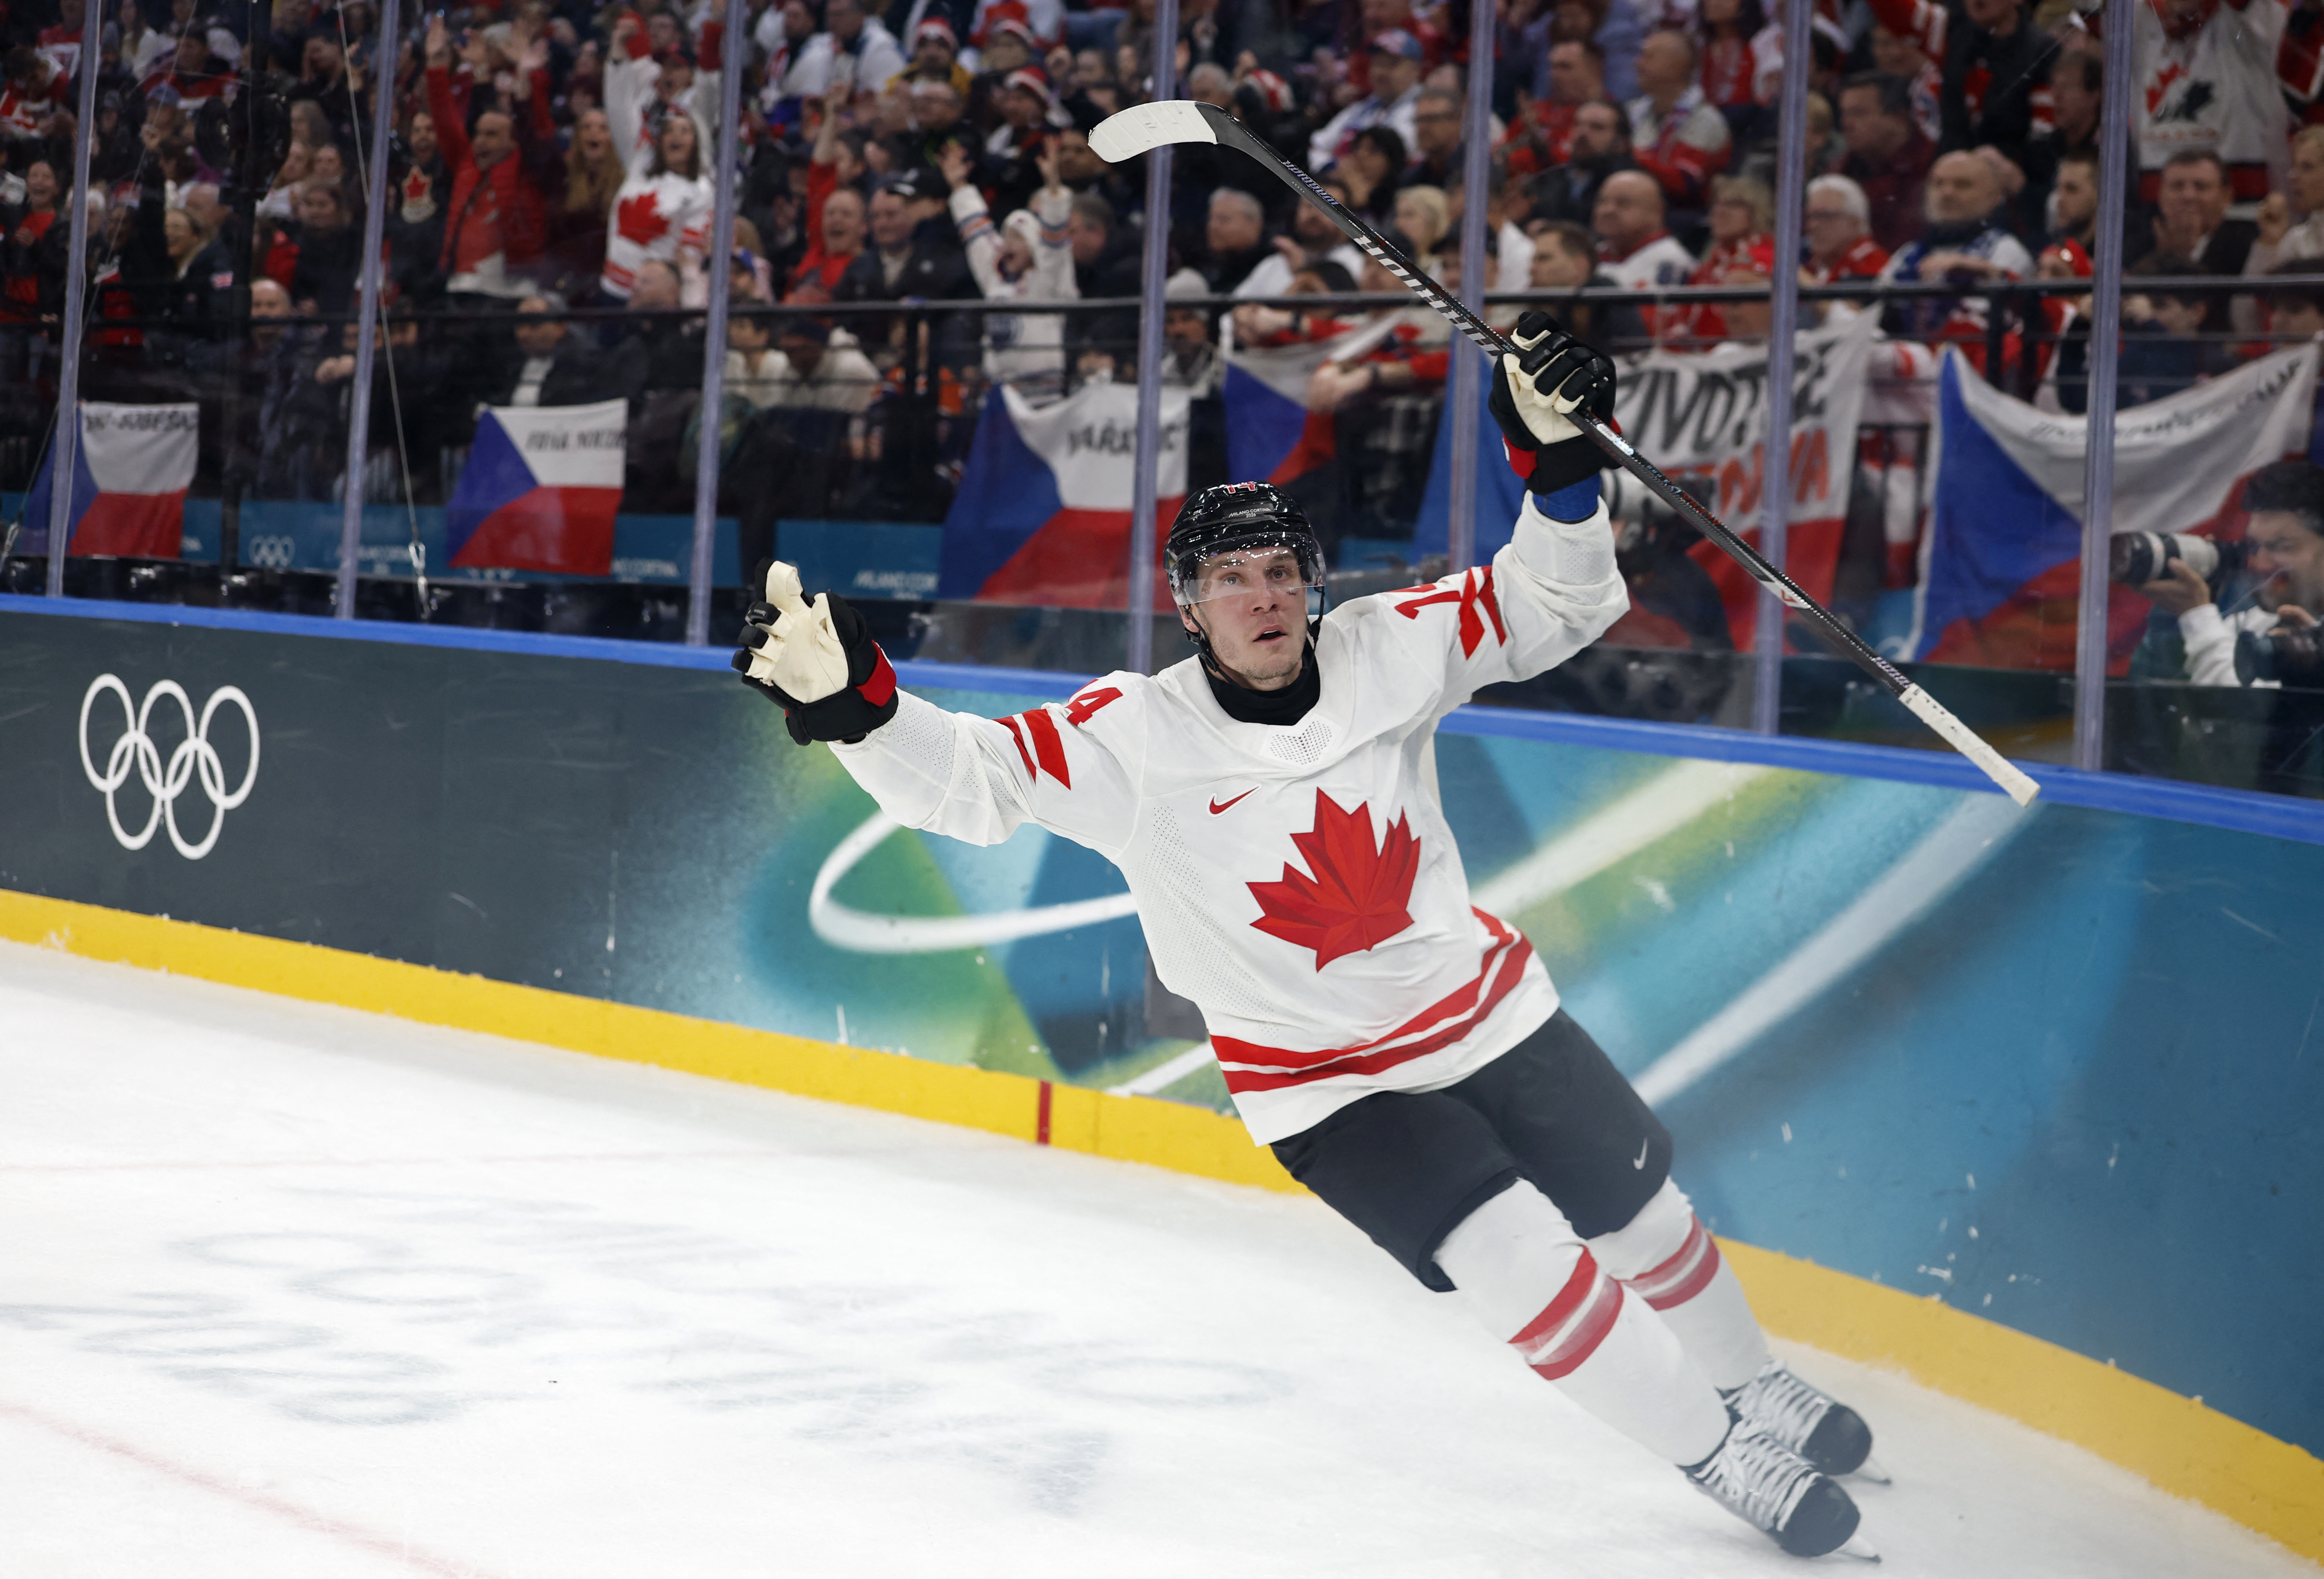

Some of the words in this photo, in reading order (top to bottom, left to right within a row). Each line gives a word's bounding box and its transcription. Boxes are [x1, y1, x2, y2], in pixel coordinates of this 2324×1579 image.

[1282, 160, 1339, 205] WARRIOR
[1354, 234, 1501, 352] ARRIOR
[1228, 509, 1250, 518] MILANO
[1682, 493, 1721, 525] ALPHA
